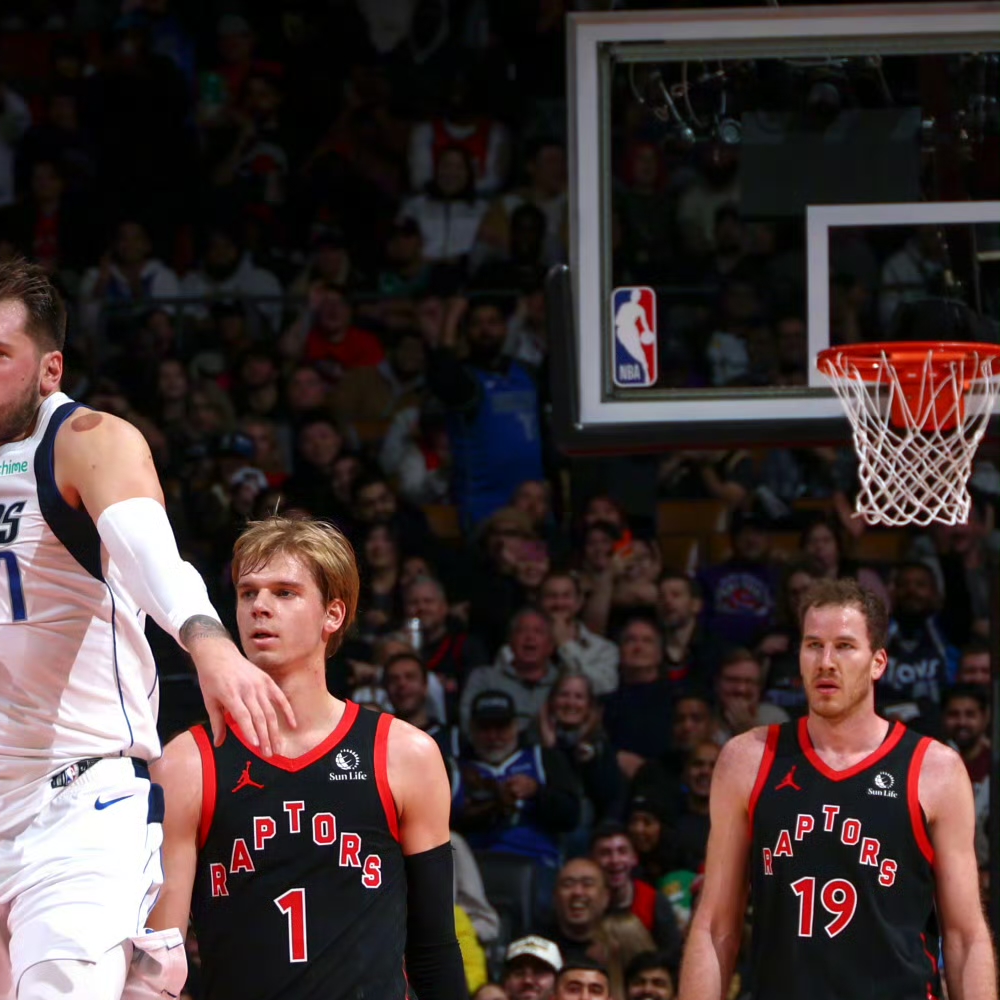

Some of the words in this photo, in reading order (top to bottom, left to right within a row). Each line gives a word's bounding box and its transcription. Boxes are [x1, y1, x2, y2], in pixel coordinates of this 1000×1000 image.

[329, 772, 348, 781] Sun
[349, 771, 367, 781] Life
[867, 787, 883, 797] Sun
[883, 788, 898, 799] Life
[209, 800, 382, 897] RAPTORS
[762, 804, 898, 887] RAPTORS
[273, 888, 308, 963] 1
[789, 876, 858, 939] 19
